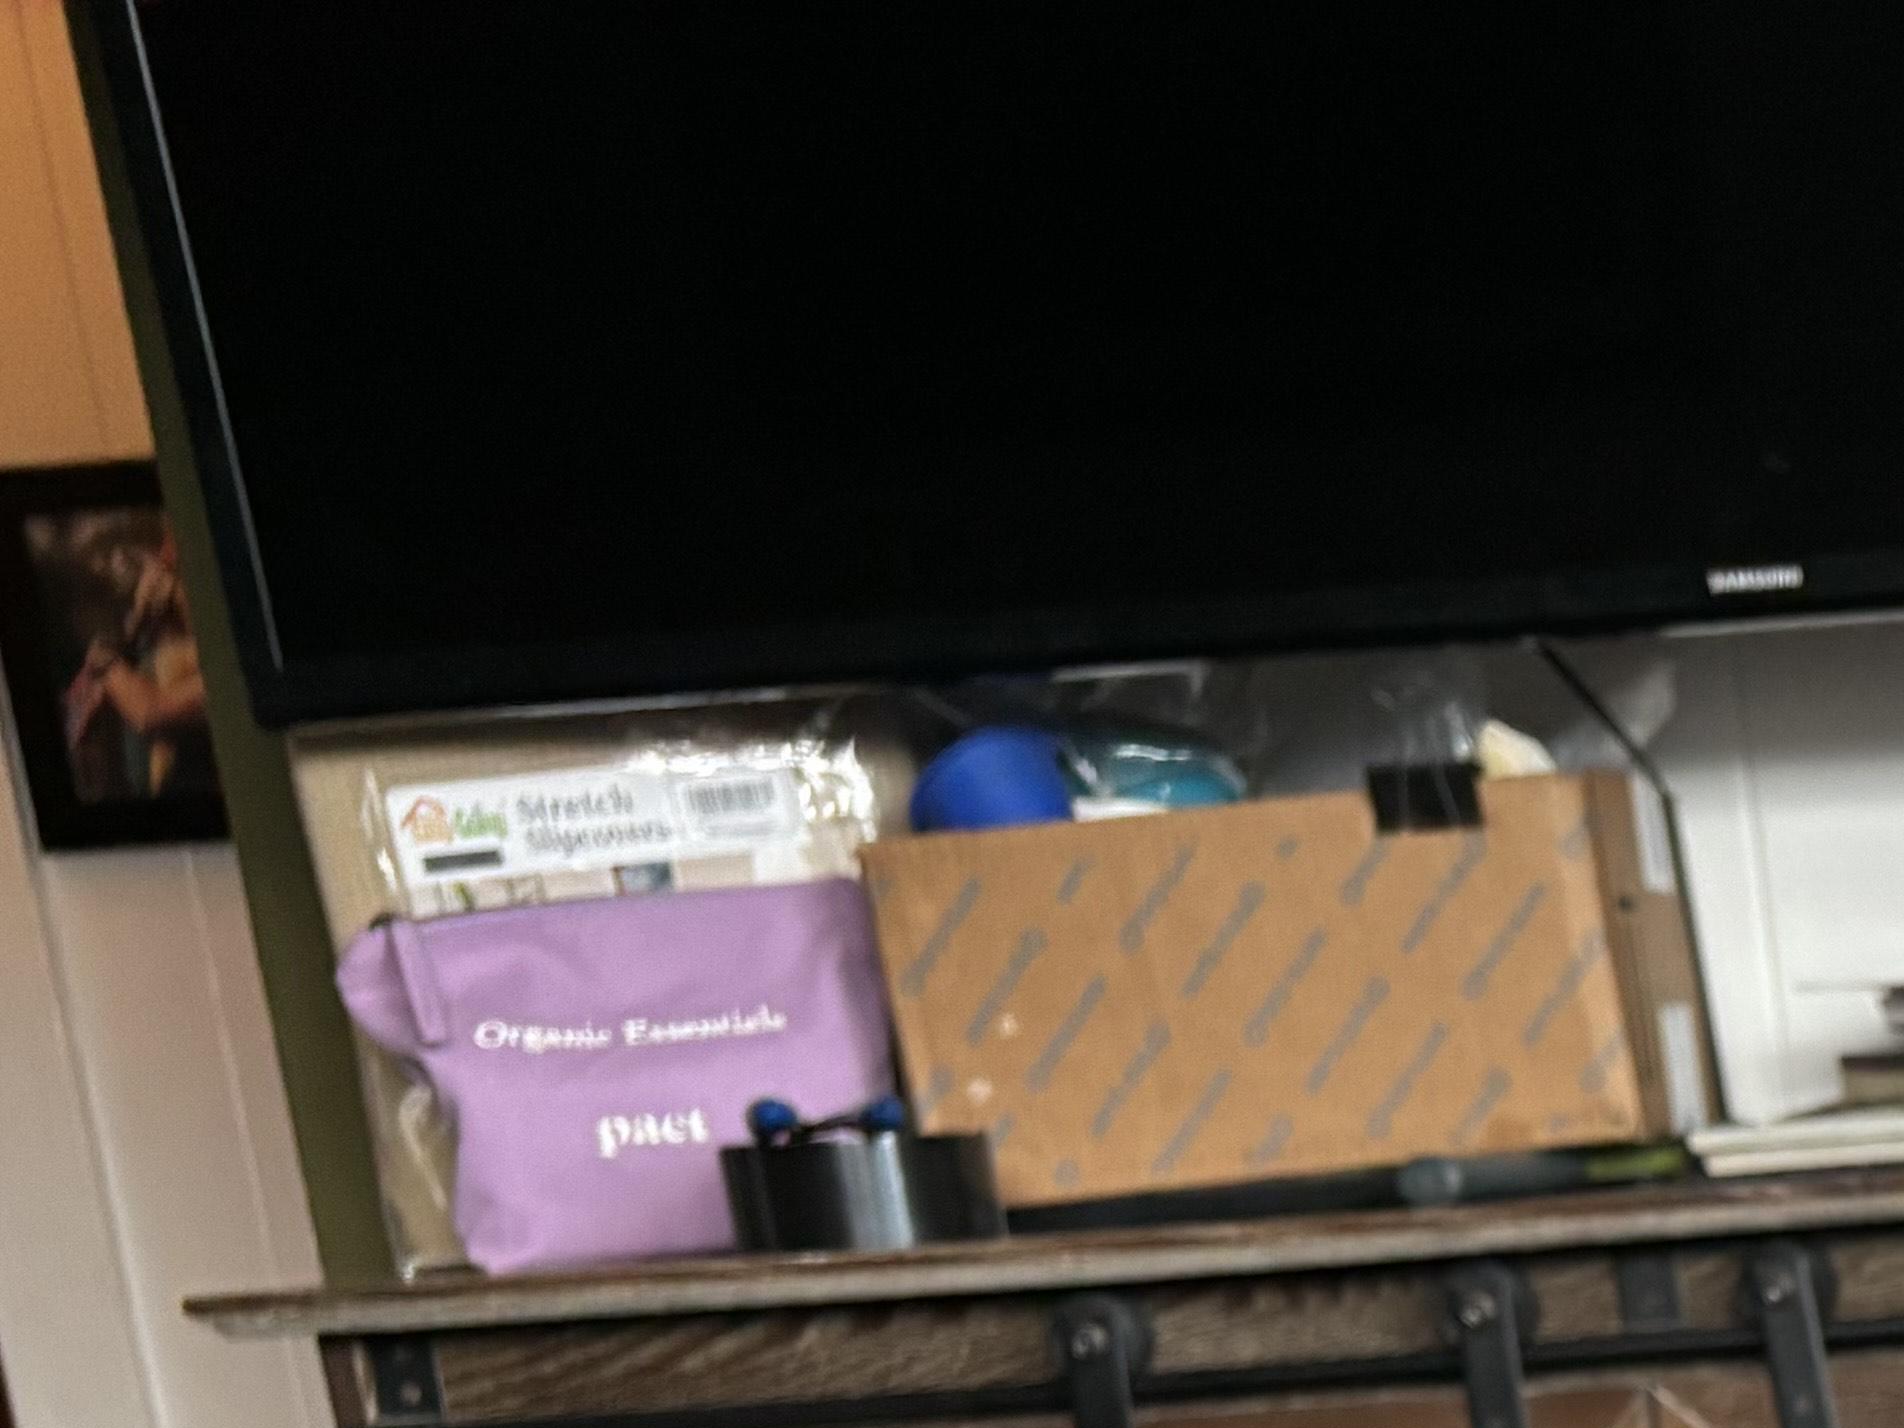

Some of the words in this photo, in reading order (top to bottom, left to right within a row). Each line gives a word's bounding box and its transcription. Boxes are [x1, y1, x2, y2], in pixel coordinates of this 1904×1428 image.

[473, 1019, 612, 1055] Organic
[621, 1004, 787, 1046] Essentials
[597, 1108, 708, 1158] pact
